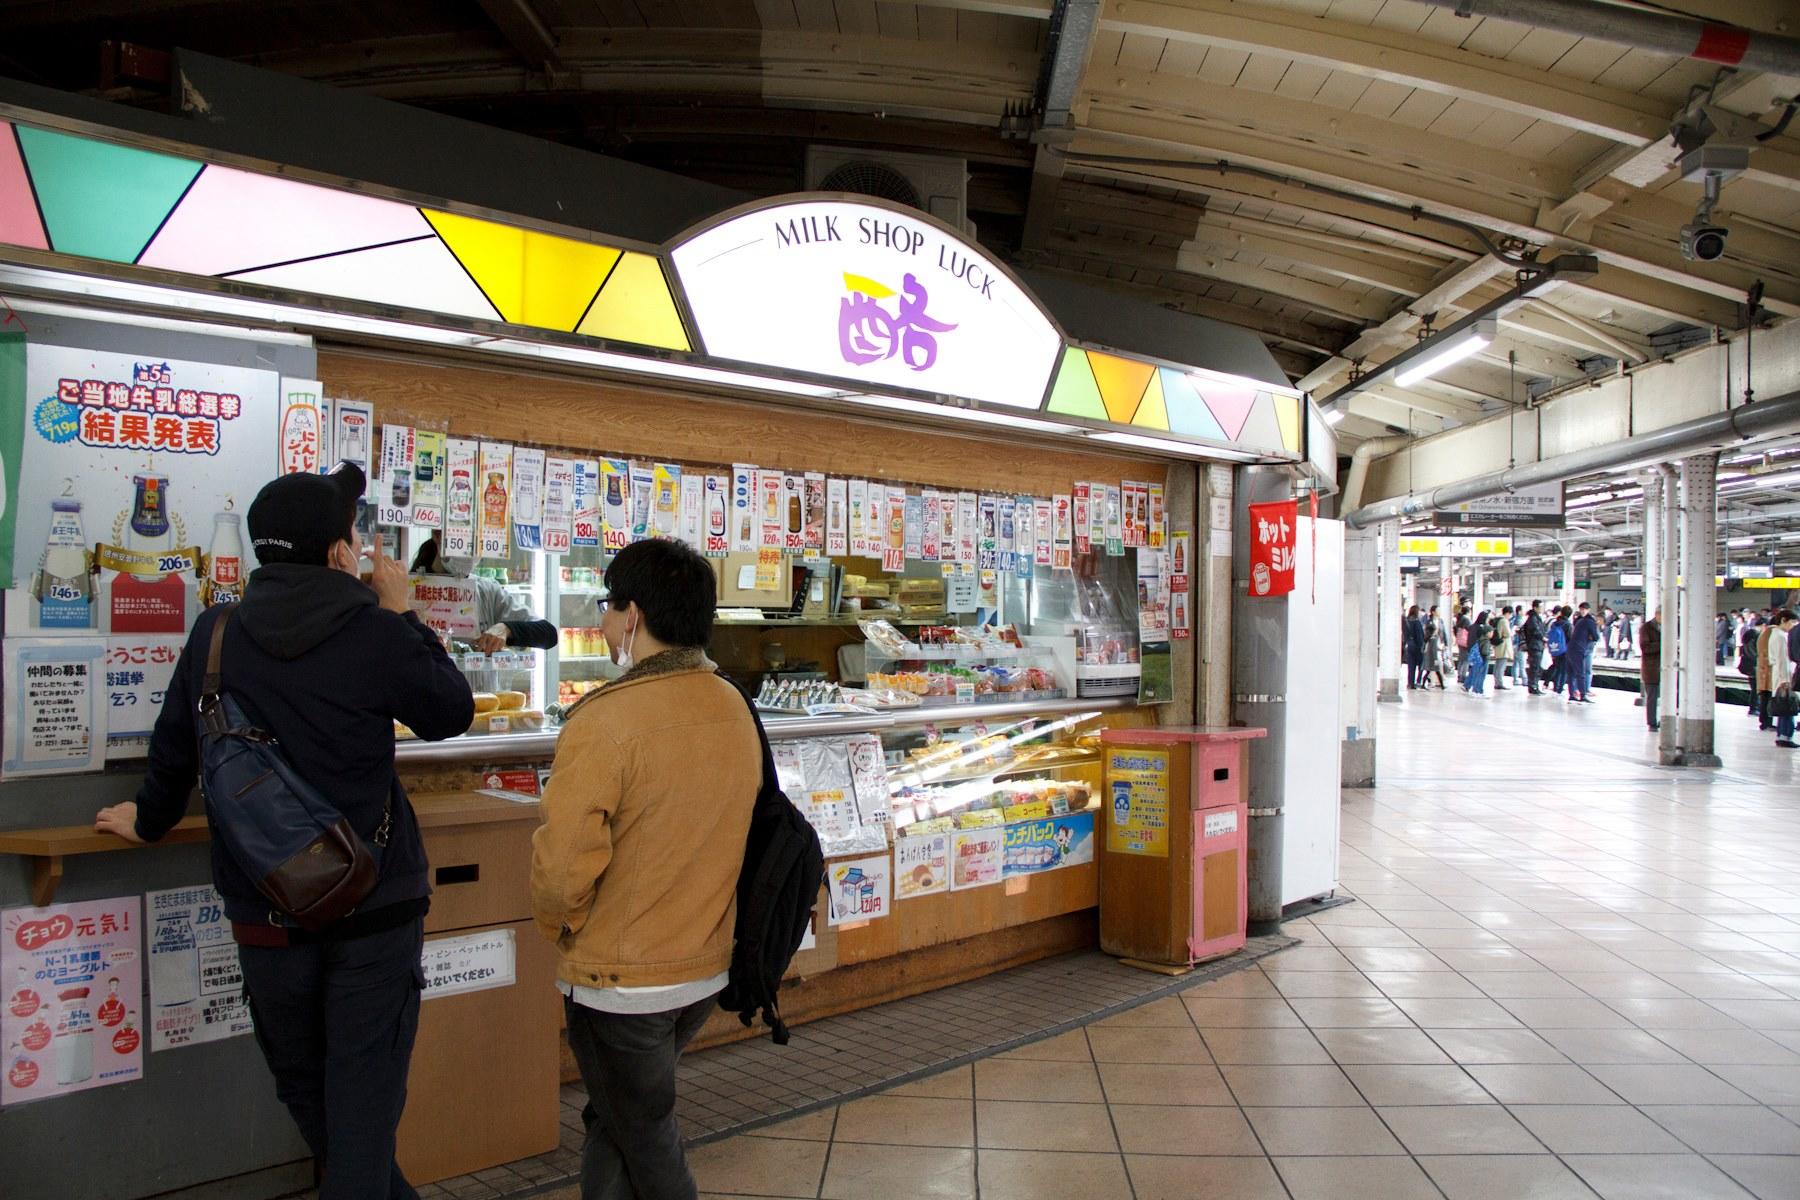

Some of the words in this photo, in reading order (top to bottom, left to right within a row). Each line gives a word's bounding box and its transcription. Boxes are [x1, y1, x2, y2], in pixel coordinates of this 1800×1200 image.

[774, 215, 841, 249] MILK
[859, 217, 925, 256] SHOP
[938, 244, 996, 301] LUCK
[58, 379, 241, 419] ご当地牛乳総選挙
[84, 410, 221, 451] 結果発表
[301, 430, 316, 473] にんじ
[61, 477, 74, 497] 2
[379, 508, 412, 524] 190円
[575, 522, 598, 538] 130円
[1258, 516, 1290, 545] ホット
[268, 538, 293, 549] PARIS
[706, 537, 728, 551] 150円
[785, 534, 804, 549] 150円
[1271, 544, 1296, 573] ミルク
[107, 646, 184, 665] うござい
[27, 664, 87, 678] 仲間の募集
[111, 692, 137, 707] 乞う
[1023, 806, 1043, 816] コーナー
[22, 919, 67, 946] チョウ
[45, 950, 101, 967] N-1乳酸菌
[35, 961, 111, 980] のむヨーグルト
[203, 1004, 246, 1016] 腸内フロー
